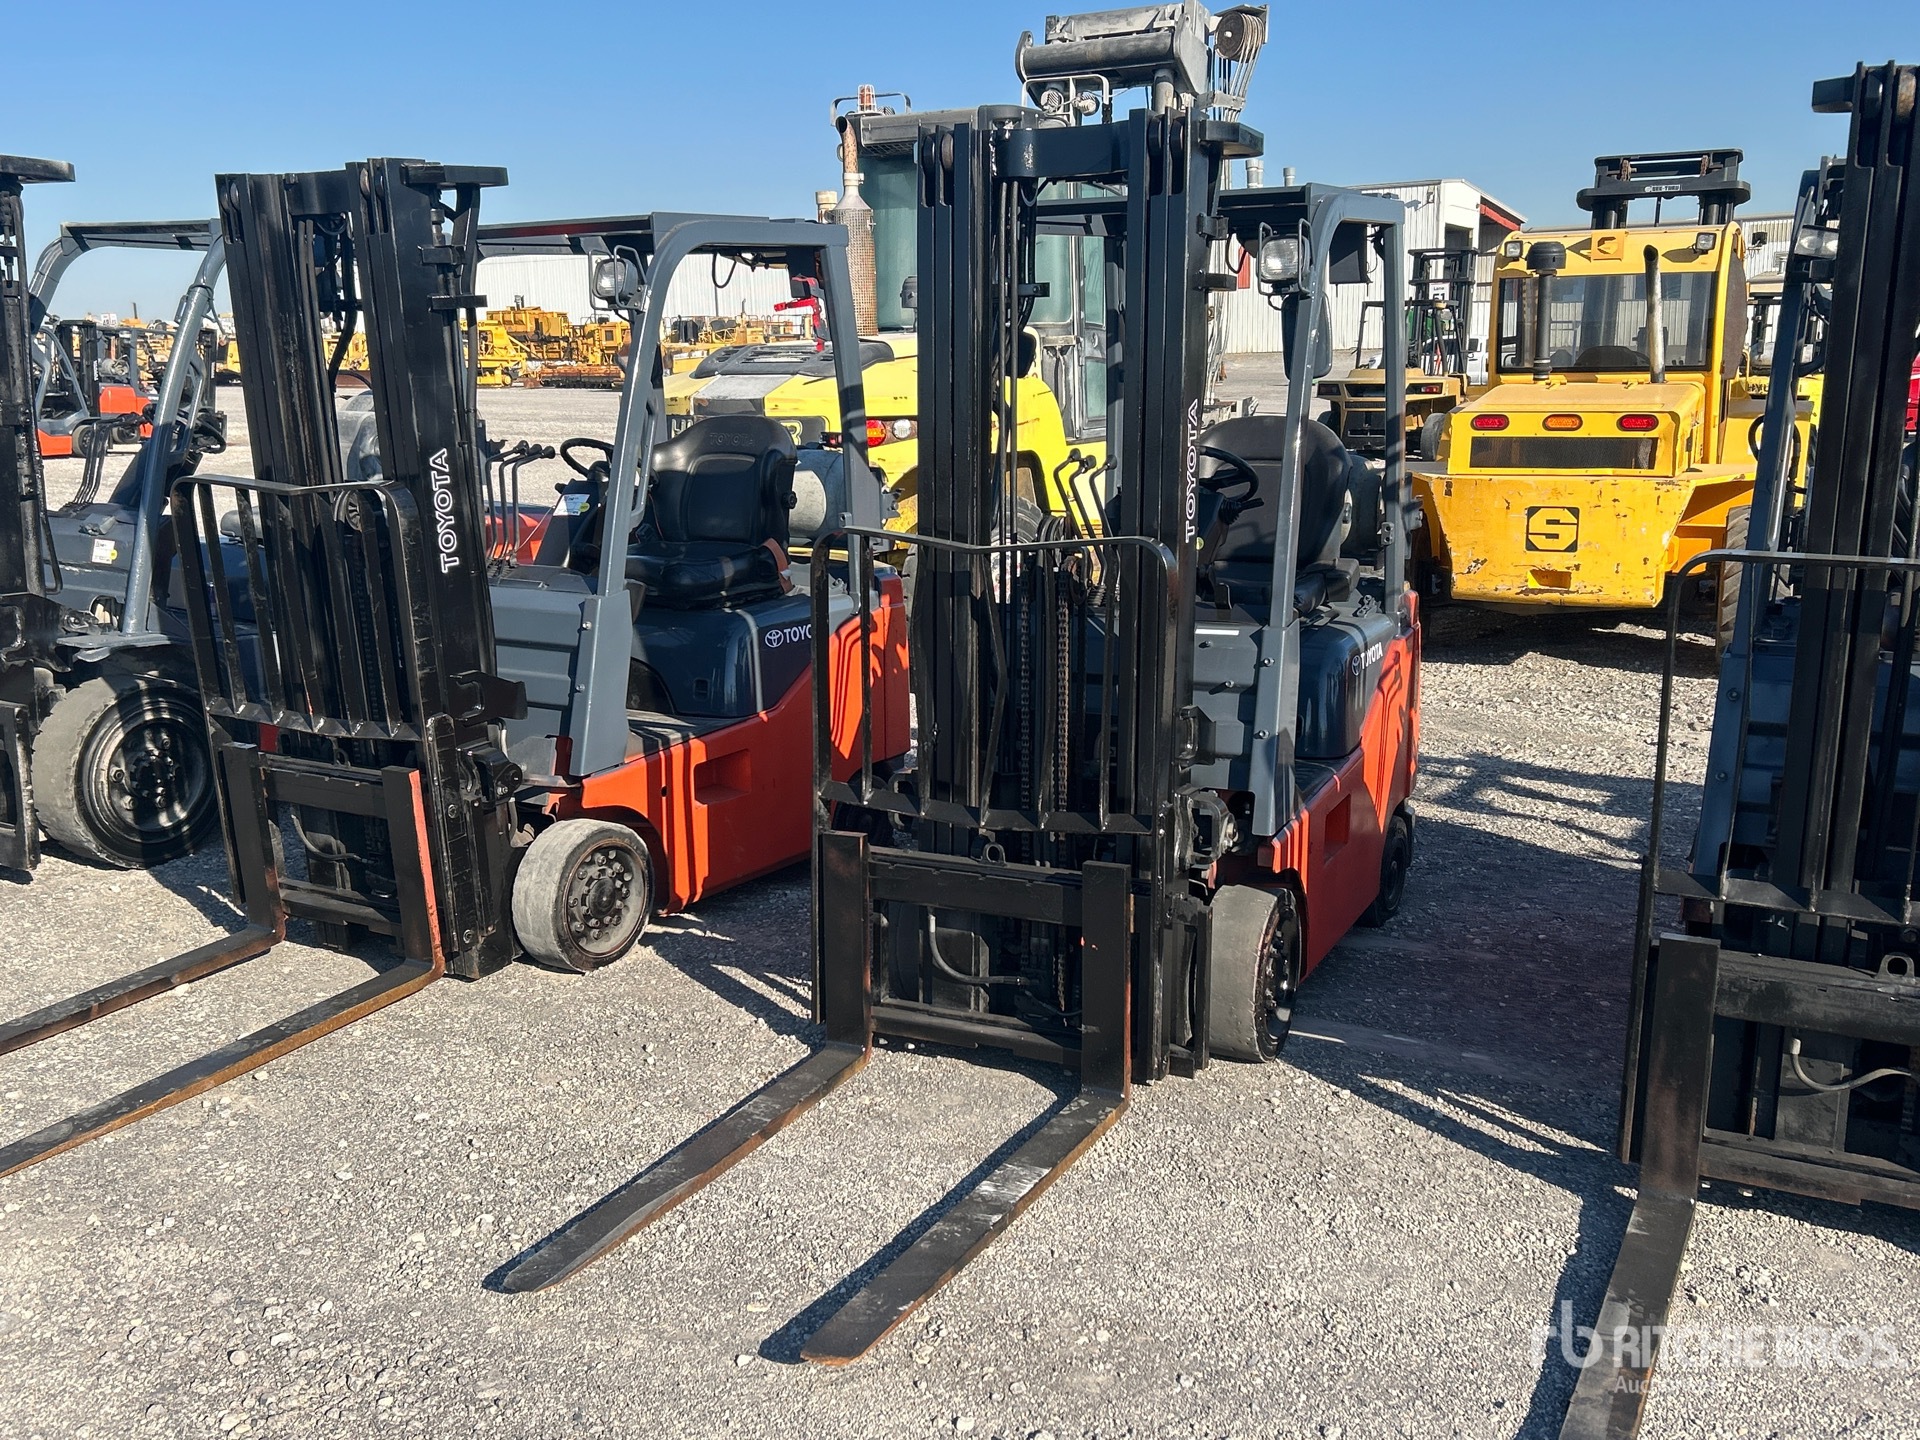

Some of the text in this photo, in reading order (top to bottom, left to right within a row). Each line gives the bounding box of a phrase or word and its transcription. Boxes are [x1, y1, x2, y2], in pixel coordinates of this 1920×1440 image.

[709, 432, 756, 447] TOYOTA
[1186, 399, 1198, 543] TOYOTA
[429, 447, 460, 573] TOYOTA
[1361, 641, 1384, 670] TOYOTA
